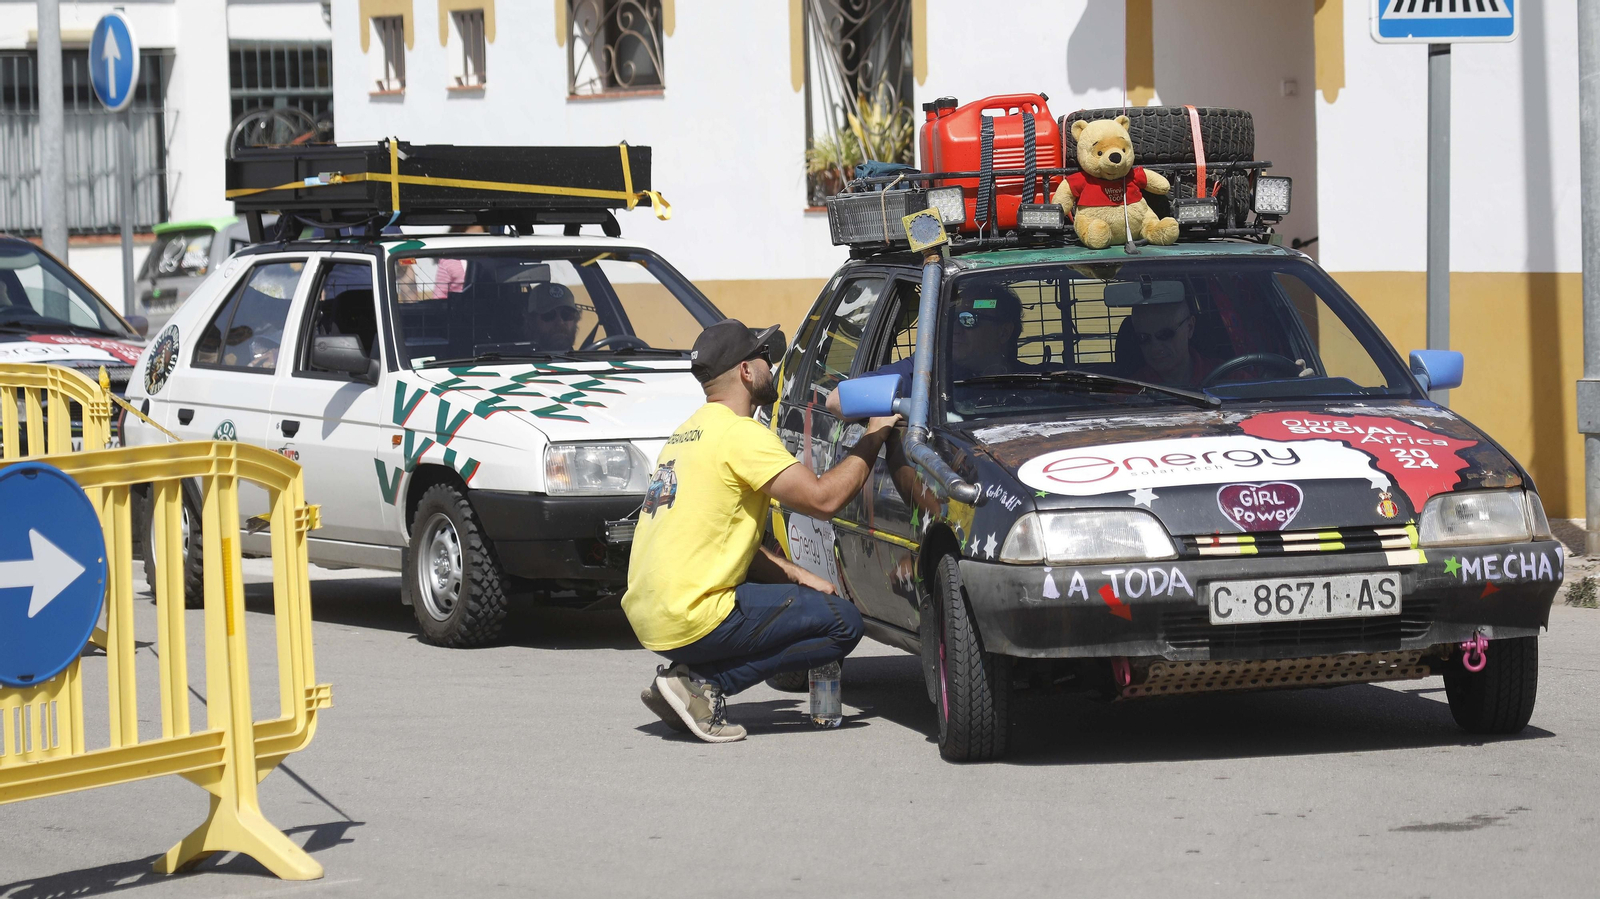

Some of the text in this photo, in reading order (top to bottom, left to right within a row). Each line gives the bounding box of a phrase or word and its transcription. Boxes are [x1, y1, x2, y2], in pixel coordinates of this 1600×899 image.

[1281, 418, 1349, 427] Obra
[1287, 426, 1408, 436] SOCIAL
[1389, 448, 1430, 458] 20
[1043, 447, 1301, 484] energy
[1397, 457, 1439, 469] 24
[1130, 463, 1224, 477] solar tech
[1461, 547, 1563, 584] MECHA!
[1101, 566, 1194, 599] TODA
